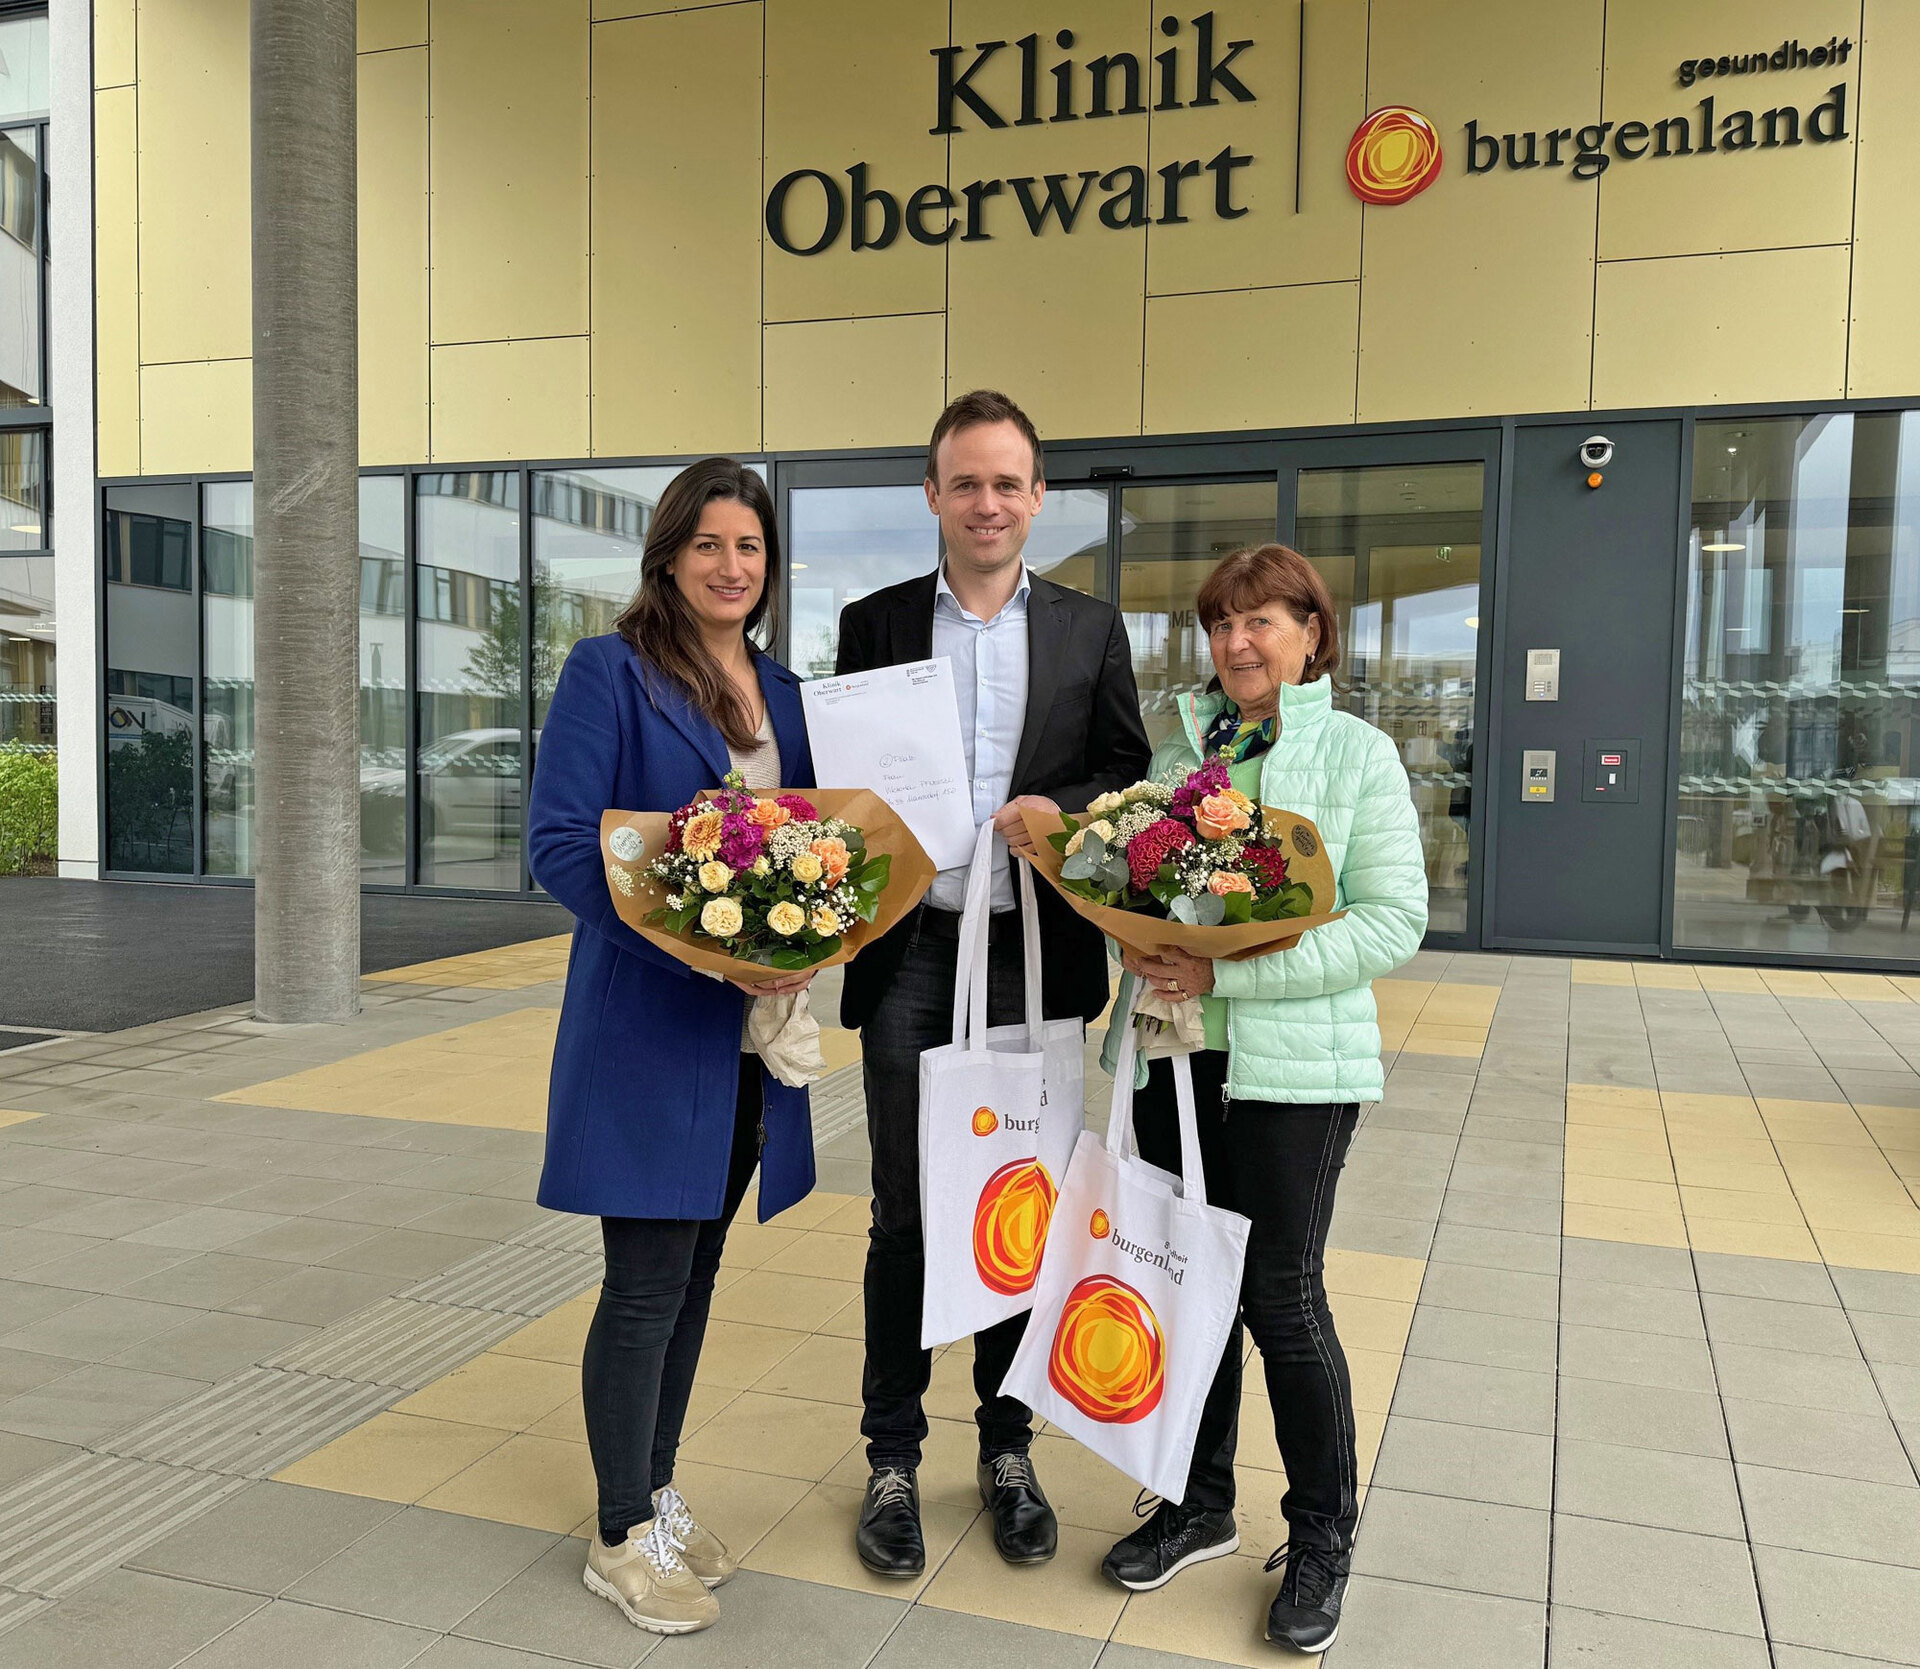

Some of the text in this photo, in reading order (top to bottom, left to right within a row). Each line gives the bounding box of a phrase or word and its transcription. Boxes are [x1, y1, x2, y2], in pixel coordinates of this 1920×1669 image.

[929, 10, 1257, 136] Klinik
[1678, 36, 1853, 88] gesundheit
[1464, 82, 1850, 180] burgenland
[765, 144, 1255, 257] Oberwart
[1111, 1228, 1185, 1286] burgenlnd
